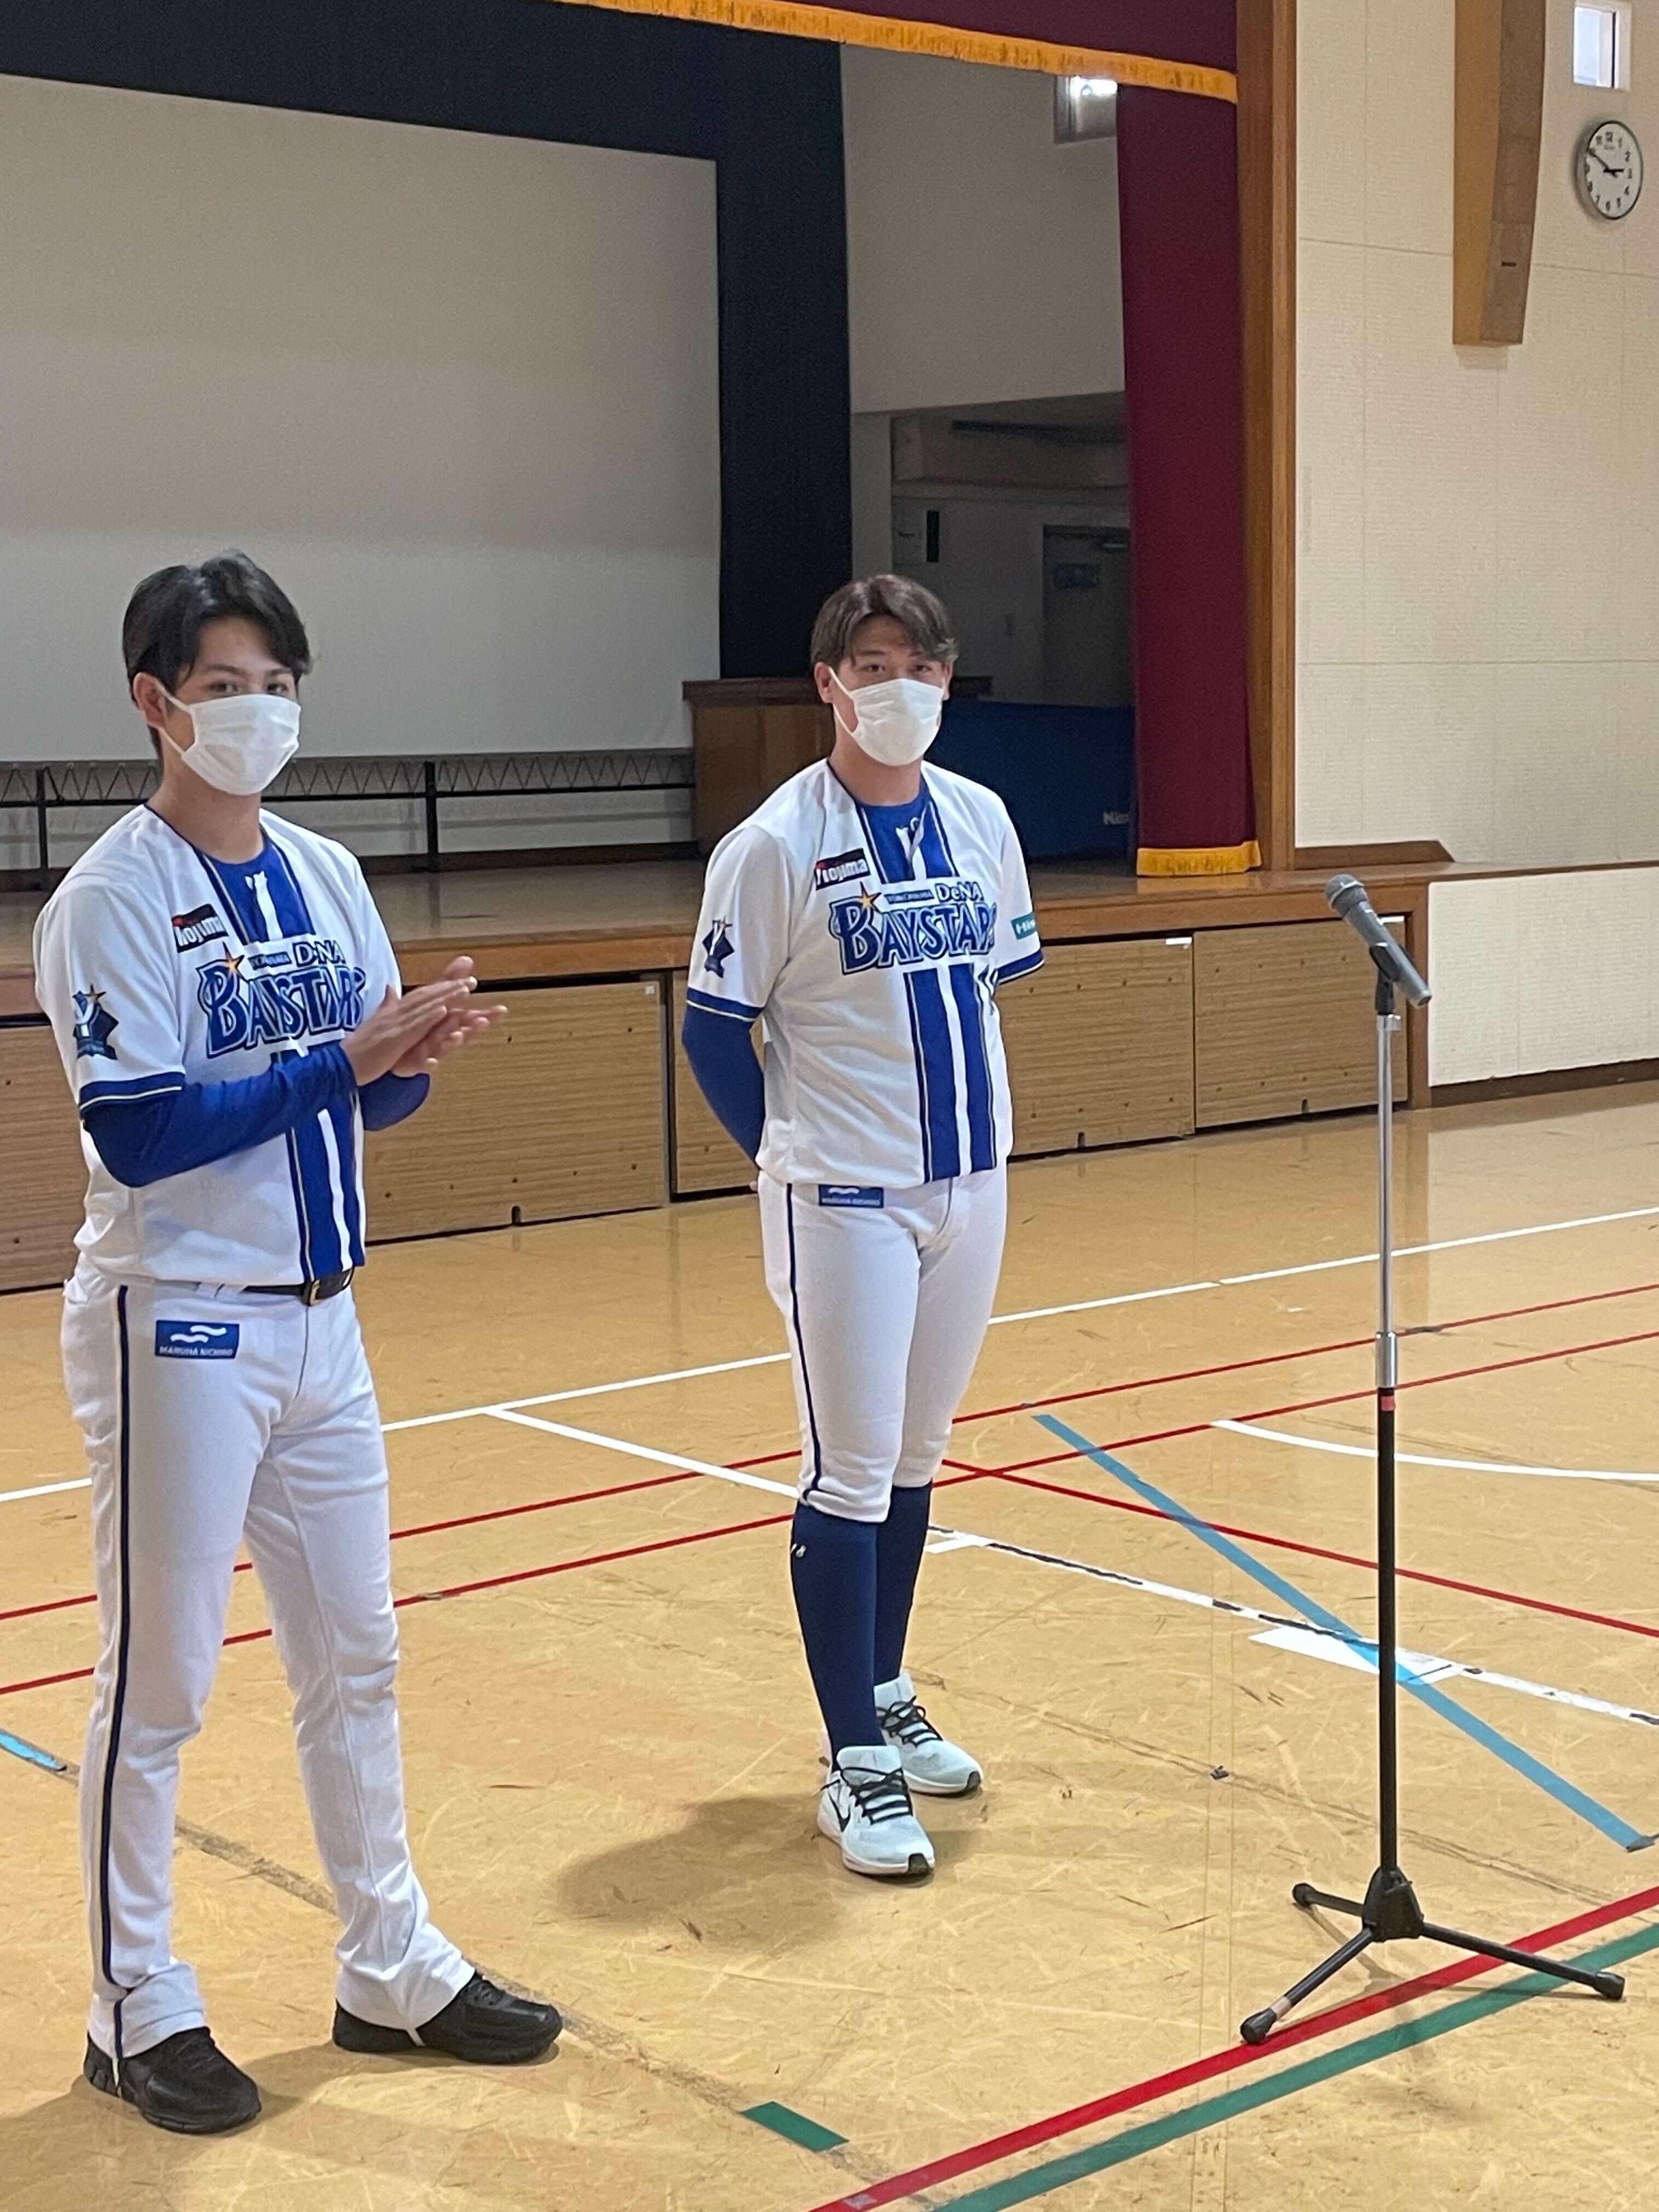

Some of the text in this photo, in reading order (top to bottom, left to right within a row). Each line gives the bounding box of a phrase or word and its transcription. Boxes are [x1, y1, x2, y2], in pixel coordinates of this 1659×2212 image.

[934, 881, 984, 902] DeNA
[828, 895, 997, 975] BAYSTAR
[292, 940, 346, 967] DNA
